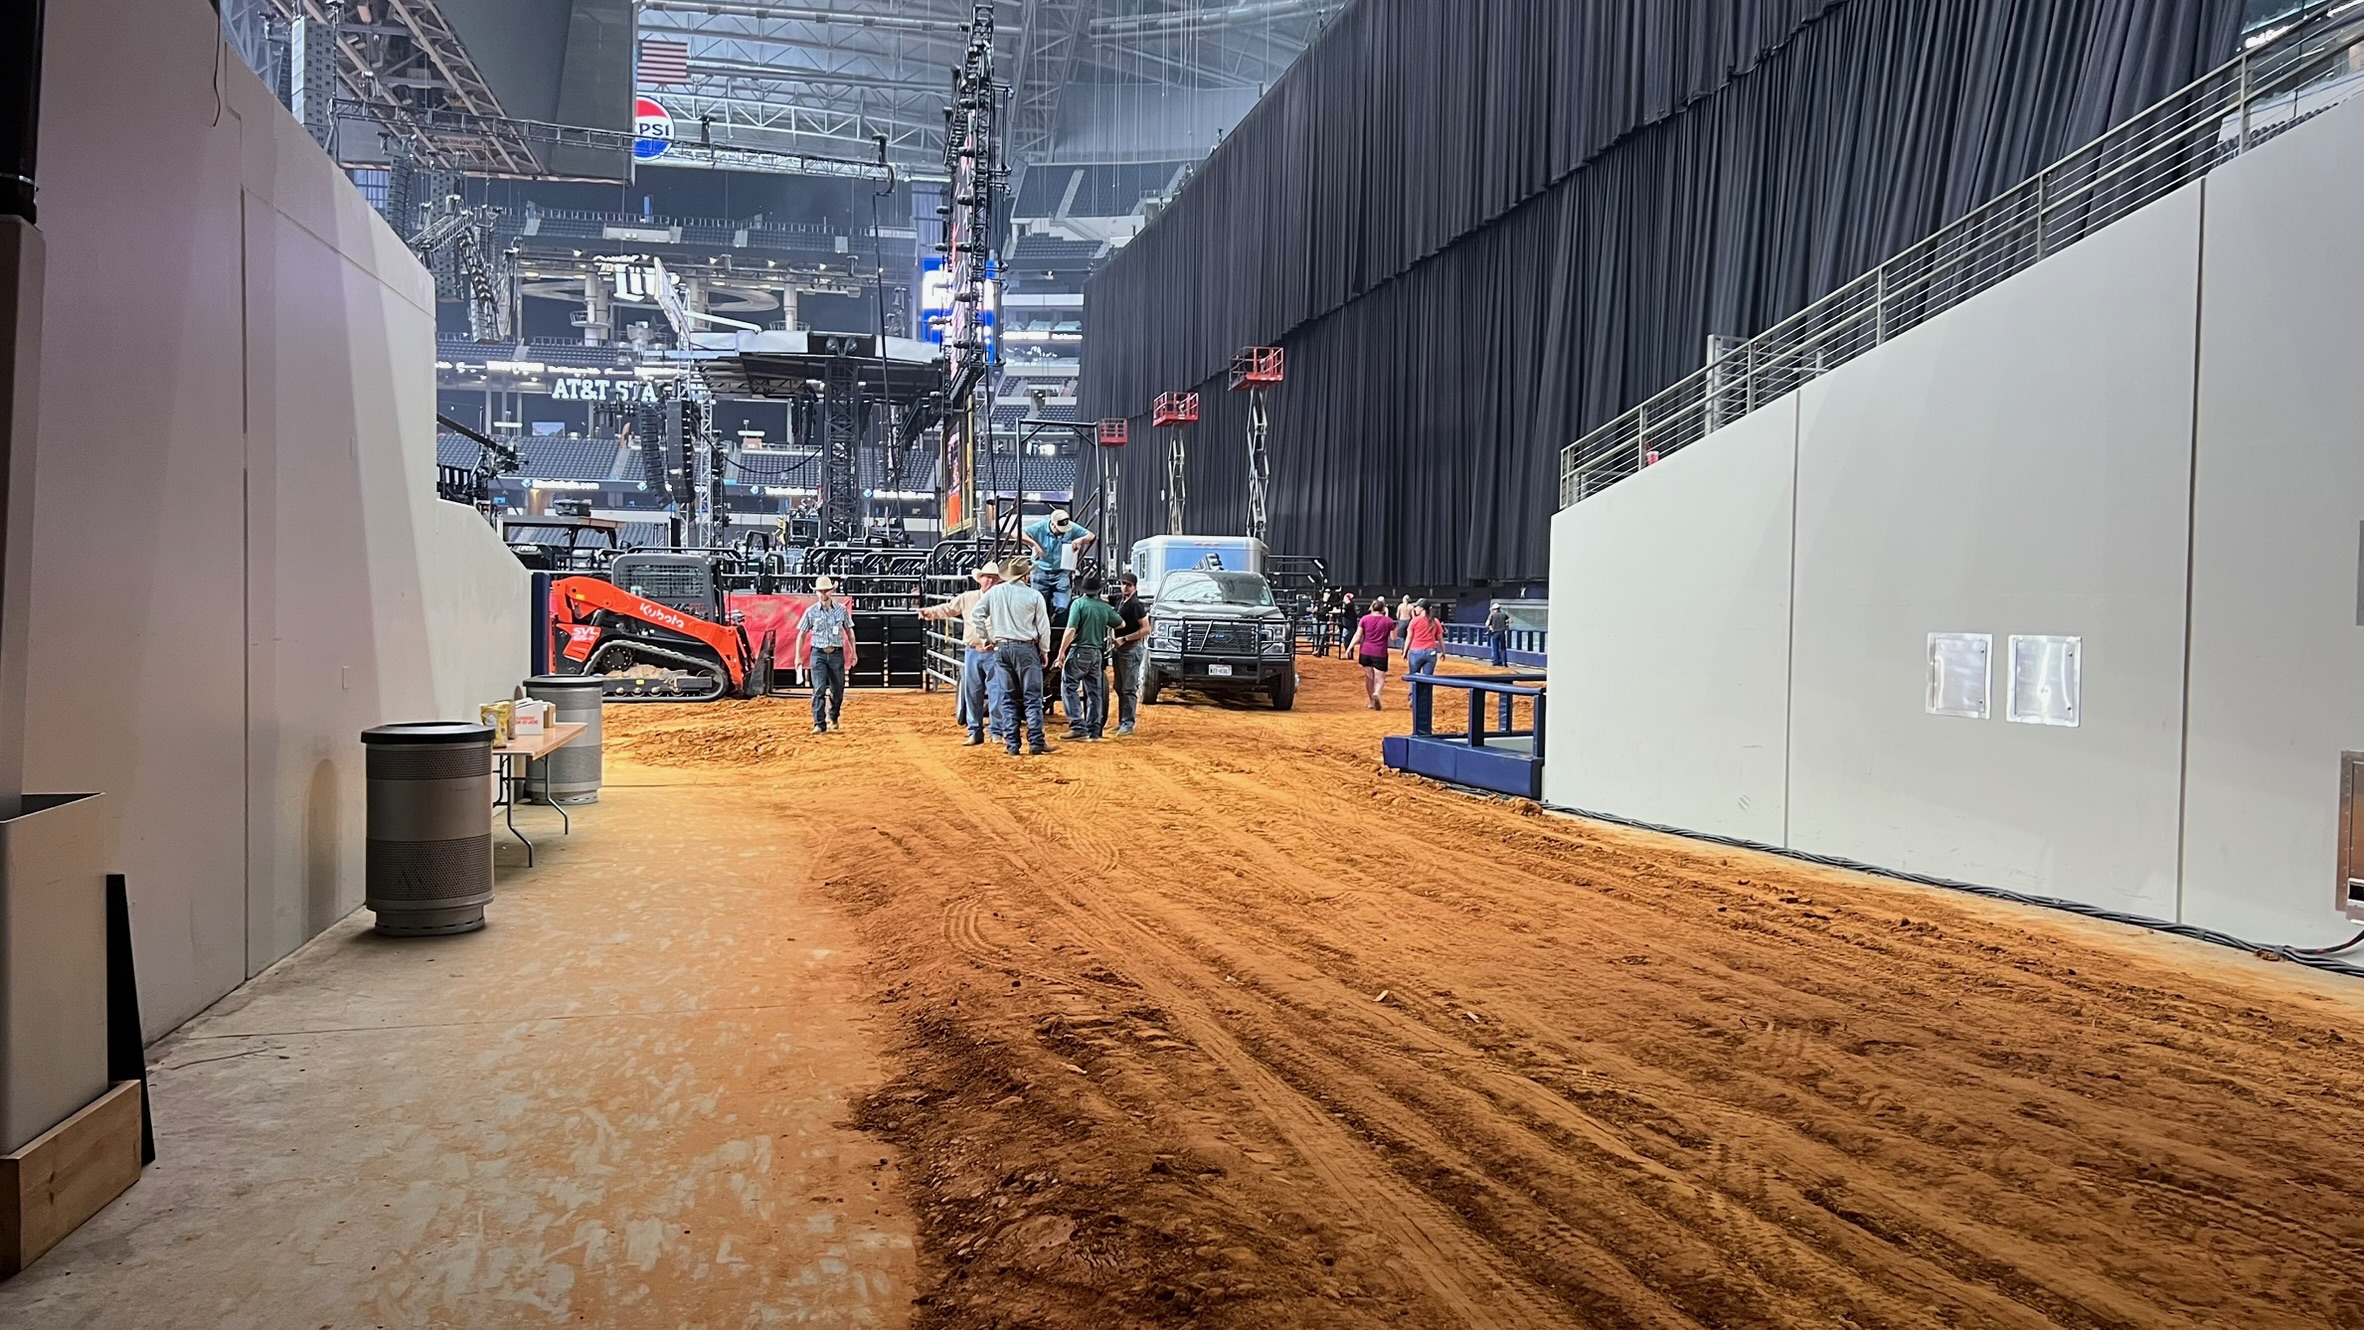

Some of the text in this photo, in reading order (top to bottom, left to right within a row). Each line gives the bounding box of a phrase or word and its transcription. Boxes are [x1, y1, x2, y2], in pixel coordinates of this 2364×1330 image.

[639, 123, 670, 136] PSI
[551, 378, 610, 400] AT&T
[639, 602, 685, 629] Kubota
[572, 627, 600, 635] SVL
